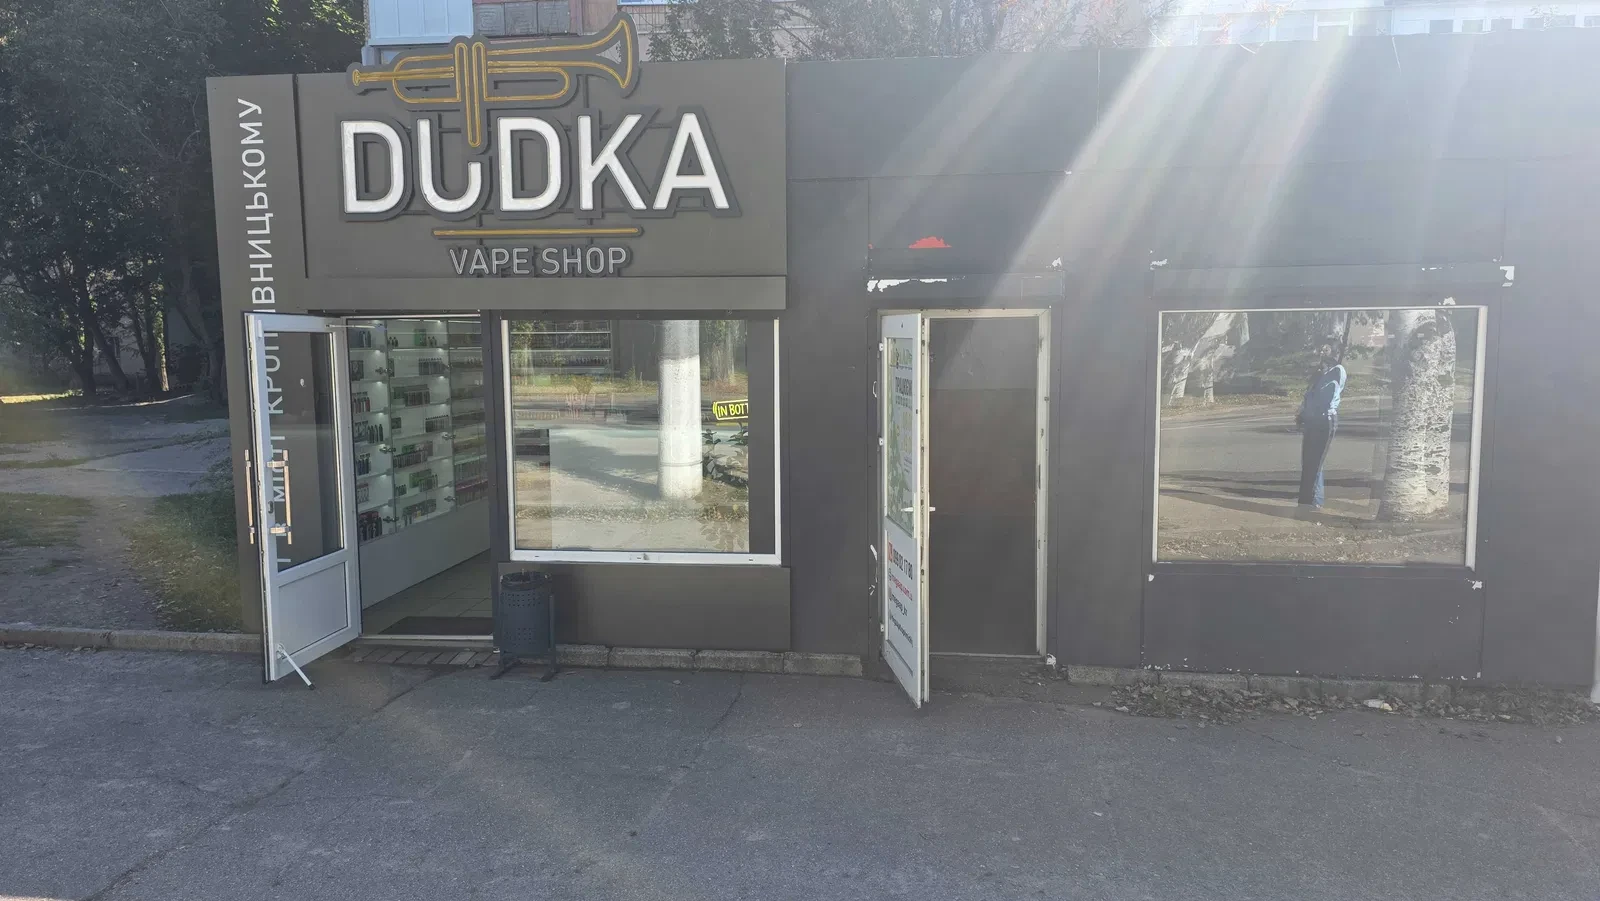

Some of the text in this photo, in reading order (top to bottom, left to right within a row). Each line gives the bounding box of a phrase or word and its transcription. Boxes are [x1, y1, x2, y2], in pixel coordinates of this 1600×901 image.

[340, 112, 730, 214] DUDKA
[238, 98, 284, 414] КРОПВНИЦЬКОМУ
[449, 245, 627, 276] VAPE SHOP
[718, 406, 728, 418] IN
